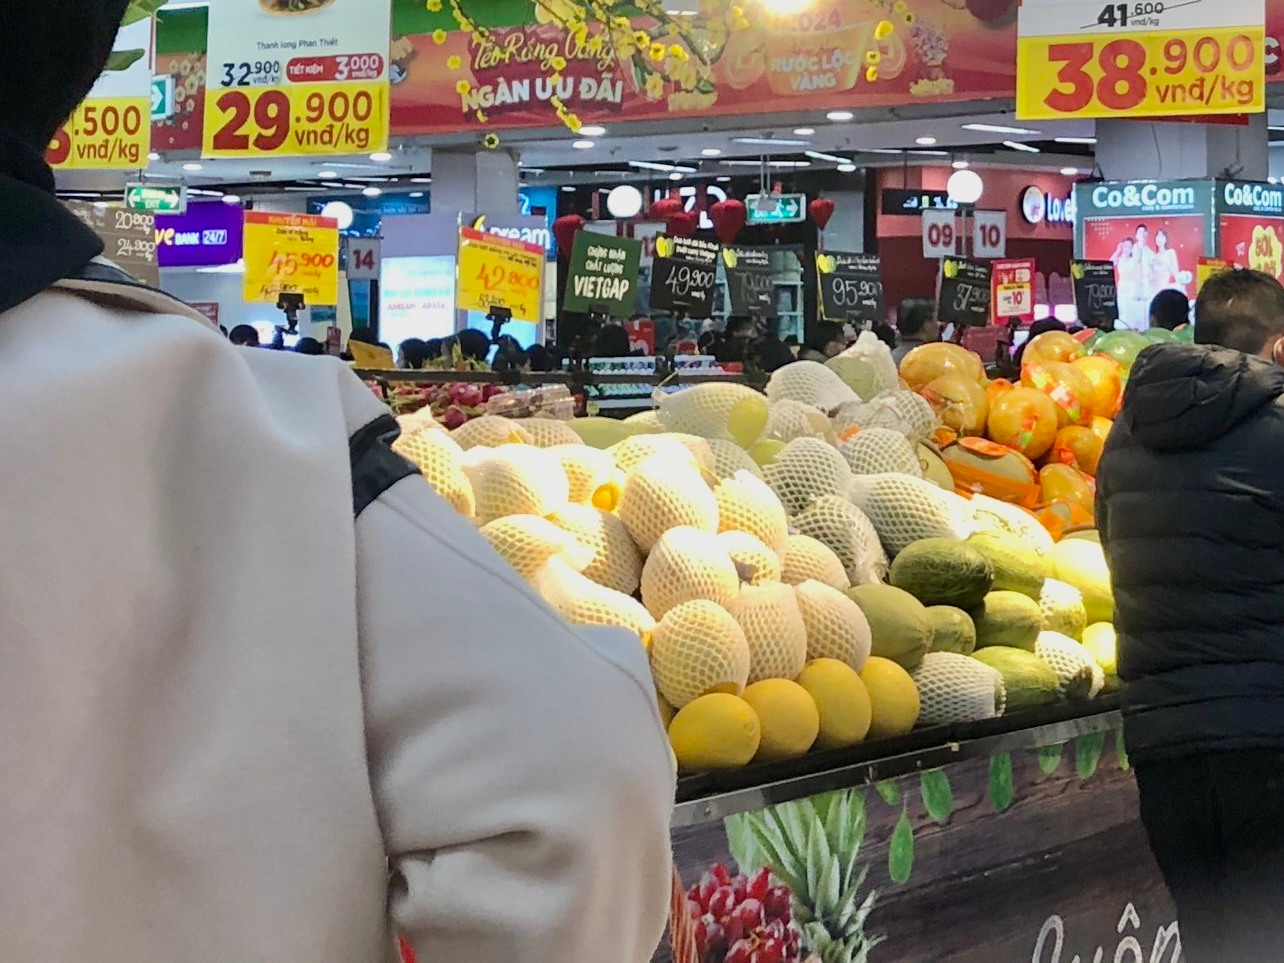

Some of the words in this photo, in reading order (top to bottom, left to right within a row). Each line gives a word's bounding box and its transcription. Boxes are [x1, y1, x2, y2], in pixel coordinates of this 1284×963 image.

[1043, 34, 1255, 112] 38.900
[461, 77, 530, 113] NGÀN
[579, 73, 624, 102] ĐÃI
[1156, 74, 1254, 106] vnđ/kg
[213, 90, 372, 151] 29.900
[295, 123, 370, 149] vnđ/kg
[77, 139, 140, 163] vnđ/kg
[1092, 185, 1194, 208] Co&Com
[1225, 183, 1282, 207] Co&Com
[928, 223, 953, 247] 09
[979, 224, 1001, 248] 10
[353, 249, 375, 270] 14
[574, 275, 630, 301] VIETGAP
